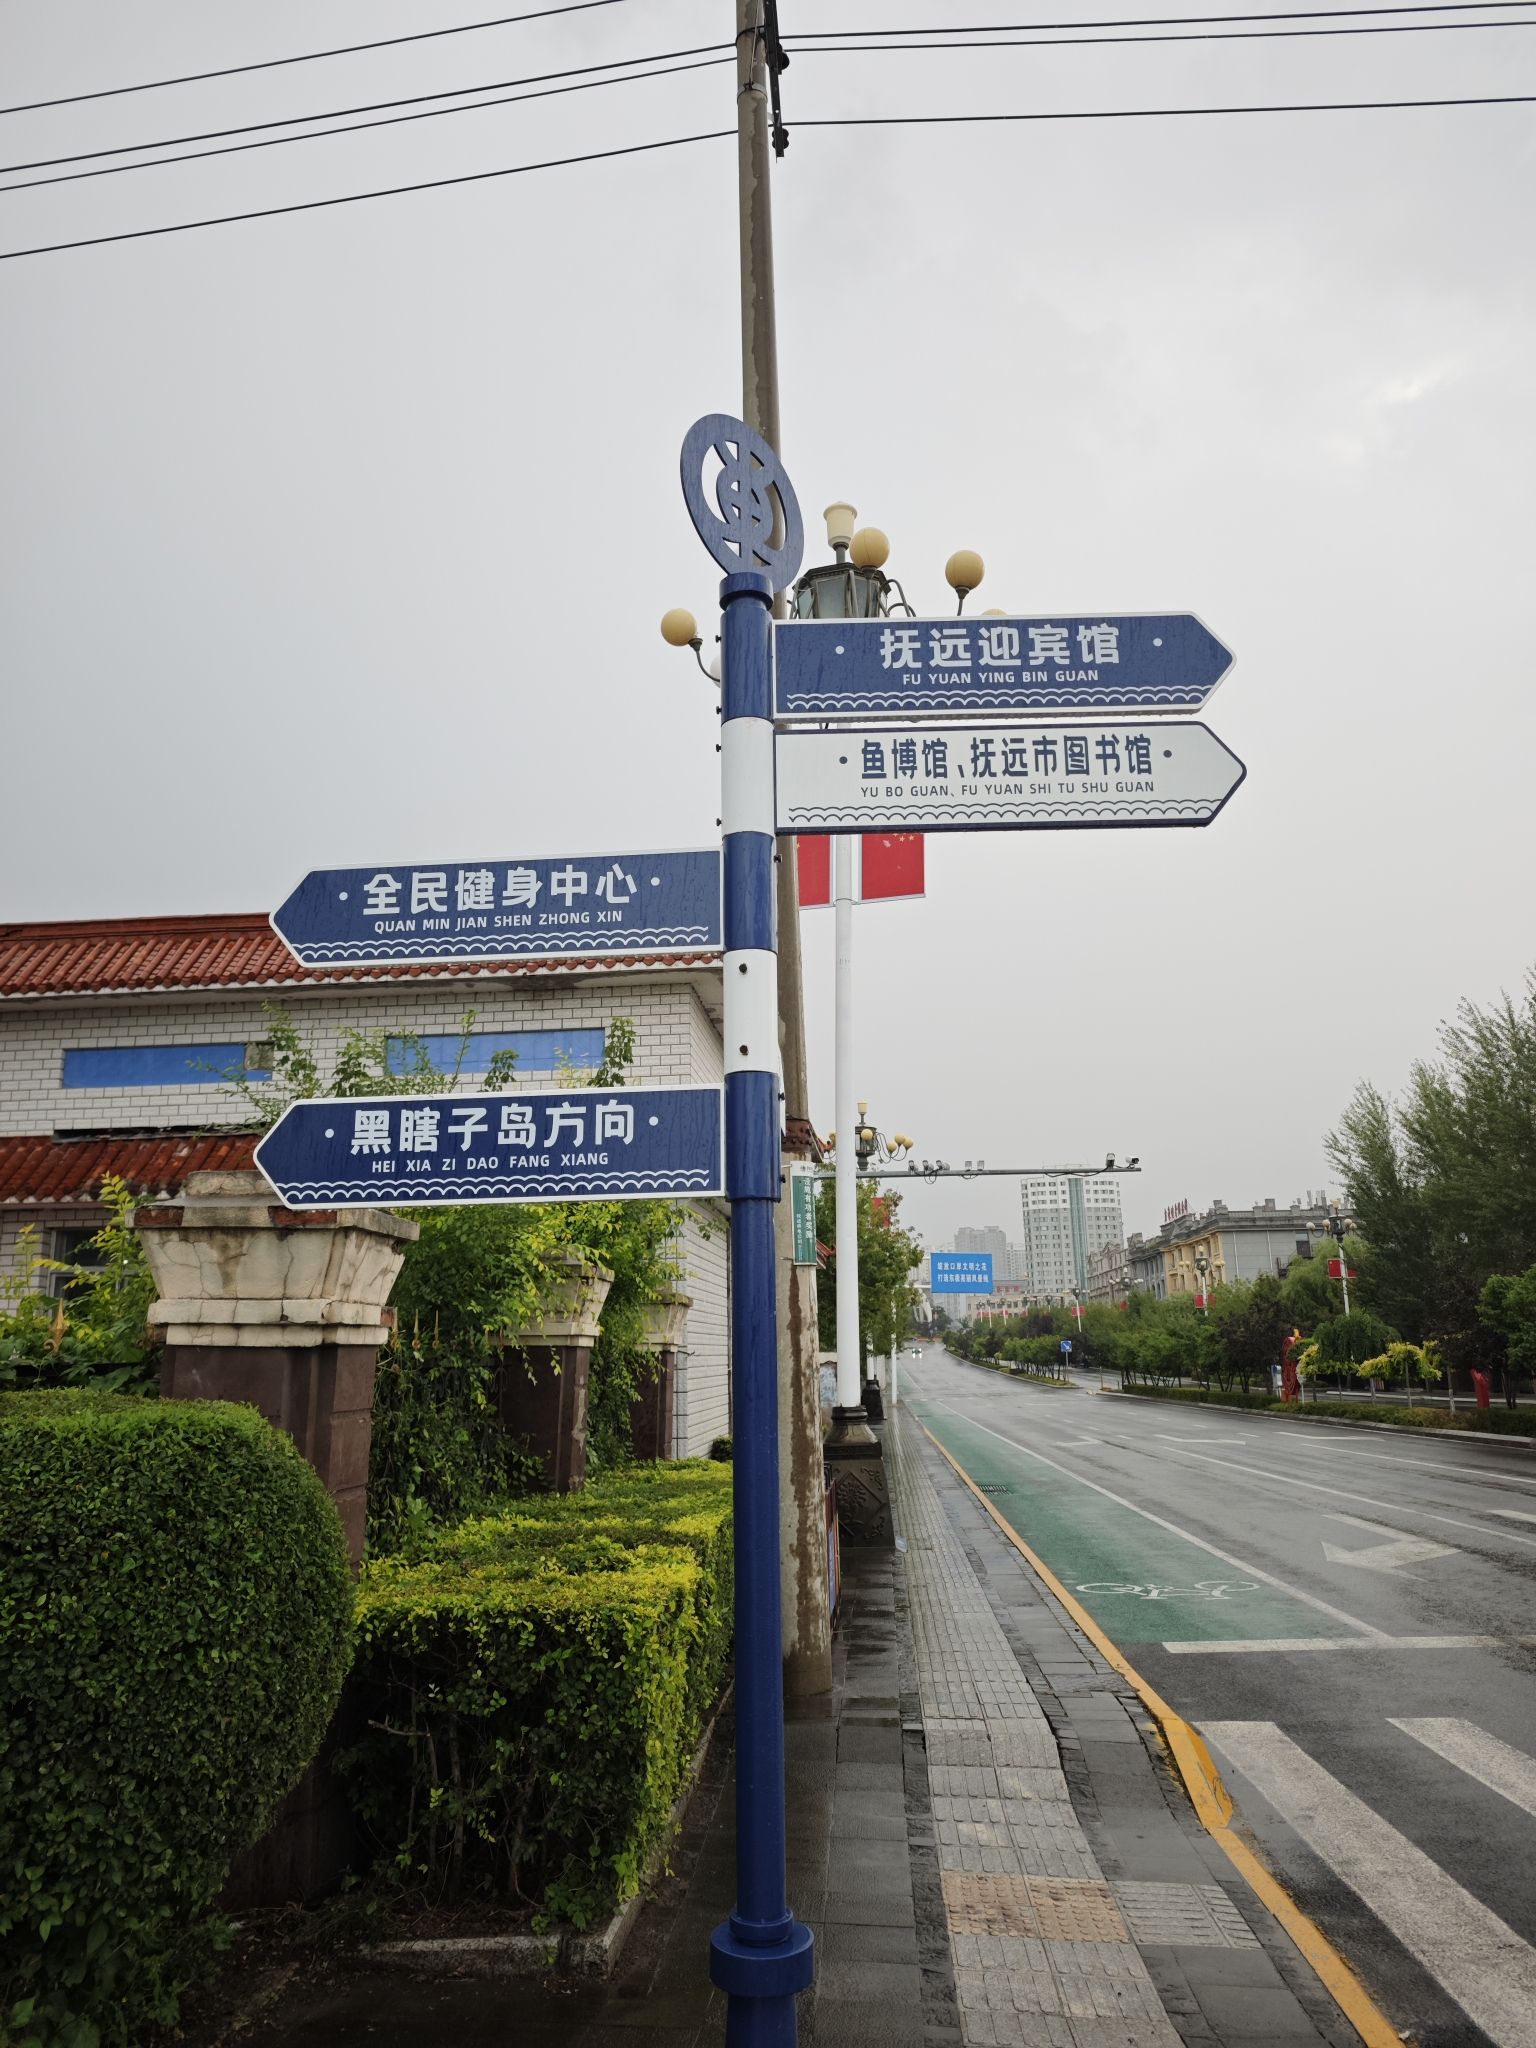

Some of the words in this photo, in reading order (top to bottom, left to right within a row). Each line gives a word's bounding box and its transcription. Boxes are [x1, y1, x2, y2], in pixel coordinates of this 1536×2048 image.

[880, 623, 1119, 669] 抚远迎宾馆
[902, 673, 921, 685] FU
[927, 672, 963, 685] YUAN
[978, 671, 1015, 684] YING
[1022, 671, 1048, 683] BIN
[1055, 669, 1099, 682] GUAN
[860, 786, 879, 798] YU
[885, 786, 904, 798] BO
[961, 784, 978, 796] FU
[984, 783, 1023, 795] YUAN
[1029, 783, 1051, 795] SHI
[1057, 782, 1075, 794] TU
[1081, 781, 1109, 794] SHU
[1115, 781, 1154, 793] GUAN
[363, 863, 638, 916] 全民健身中心
[374, 919, 416, 935] QUAN
[422, 918, 450, 931] MIN
[454, 916, 487, 932] JIAN
[494, 914, 532, 928] SHEN
[538, 911, 590, 926] ZHONG
[596, 910, 622, 923] XIN
[350, 1099, 635, 1156] 黑瞎子岛方向
[372, 1160, 396, 1173] HEI
[405, 1159, 432, 1172] XIA
[441, 1158, 456, 1171] ZI
[466, 1156, 499, 1170] DAO
[509, 1154, 550, 1169] FANG
[560, 1152, 609, 1167] XIANG
